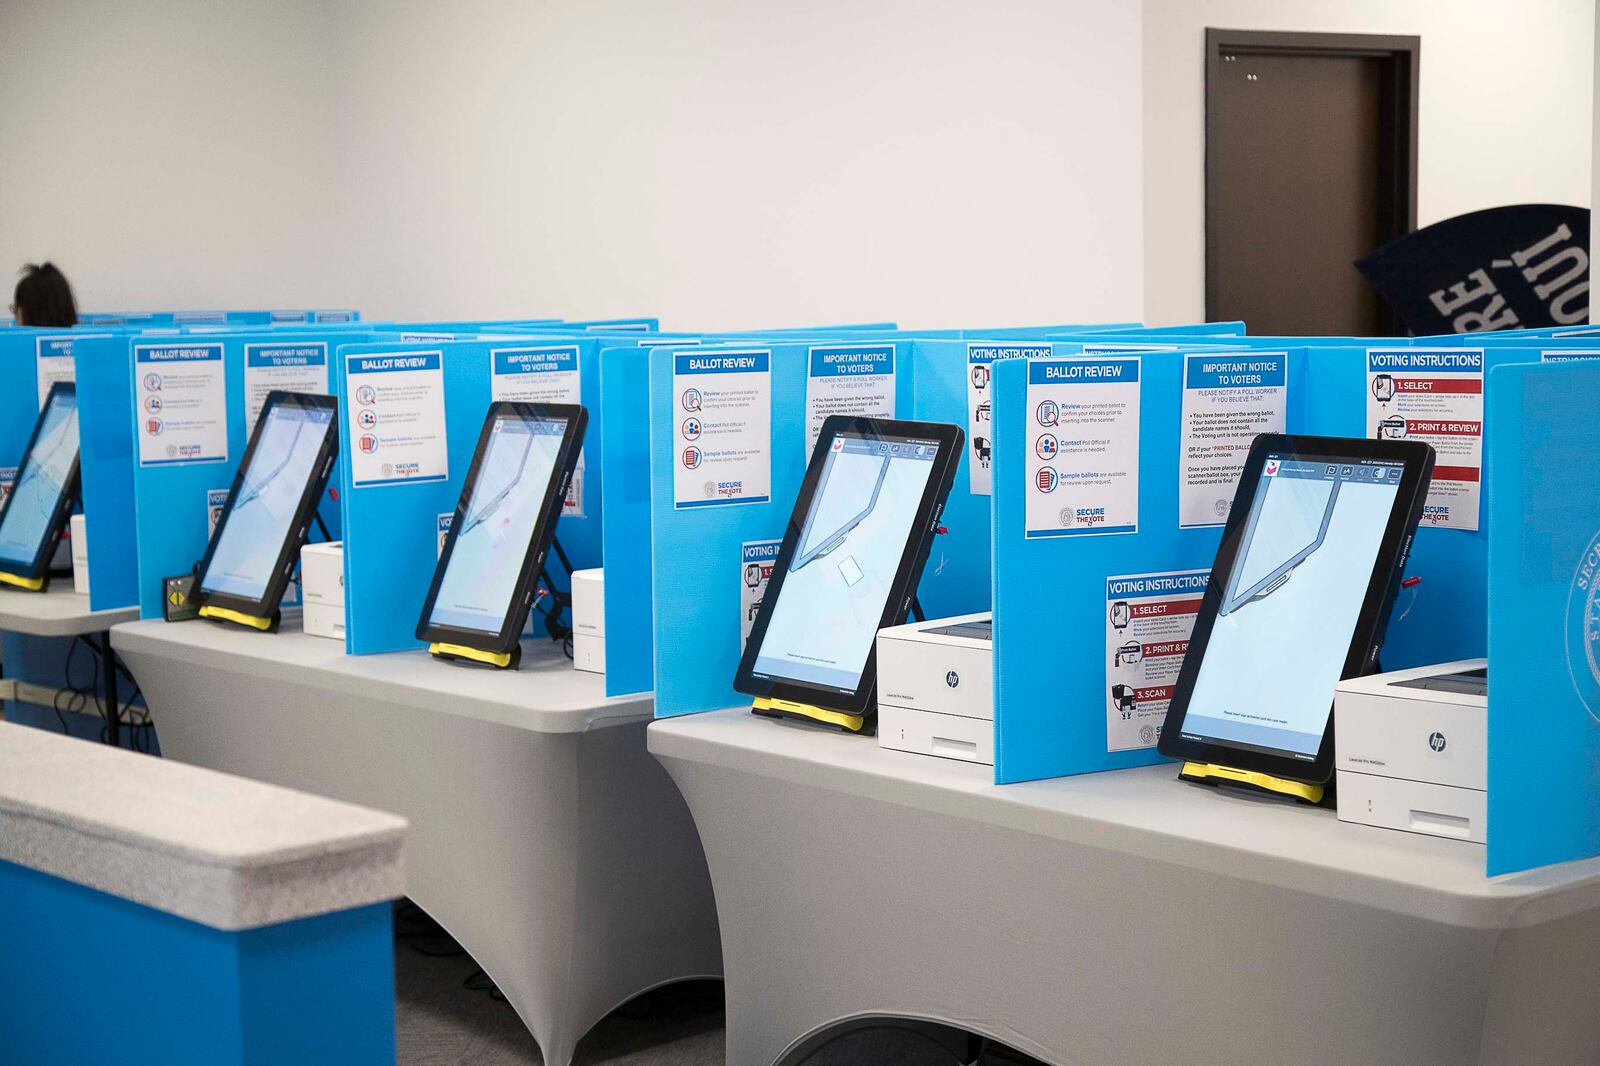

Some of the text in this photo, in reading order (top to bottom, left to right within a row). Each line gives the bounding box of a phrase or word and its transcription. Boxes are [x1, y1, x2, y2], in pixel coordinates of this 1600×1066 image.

[150, 350, 209, 359] BALLOT REVIEW
[508, 354, 545, 363] IMPORTANT
[824, 353, 886, 363] IMPORTANT NOTICE
[970, 349, 1050, 359] VOTING INSTRUCTIONS
[362, 358, 426, 369] BALLOT REVIEW
[690, 358, 755, 369] BALLOT REVIEW
[1371, 355, 1481, 366] VOTING INSTRUCTIONS
[848, 364, 873, 373] VOTERS
[1046, 366, 1122, 378] BALLOT REVIEW
[1203, 362, 1277, 372] IMPORTANT NOTICE
[1219, 375, 1261, 384] TO VOTERS
[1448, 424, 1478, 432] REVIEW
[744, 546, 773, 557] VOTING
[1110, 582, 1144, 594] VOTING
[1140, 605, 1167, 614] SELECT
[946, 671, 958, 688] hp
[1430, 732, 1445, 752] hp
